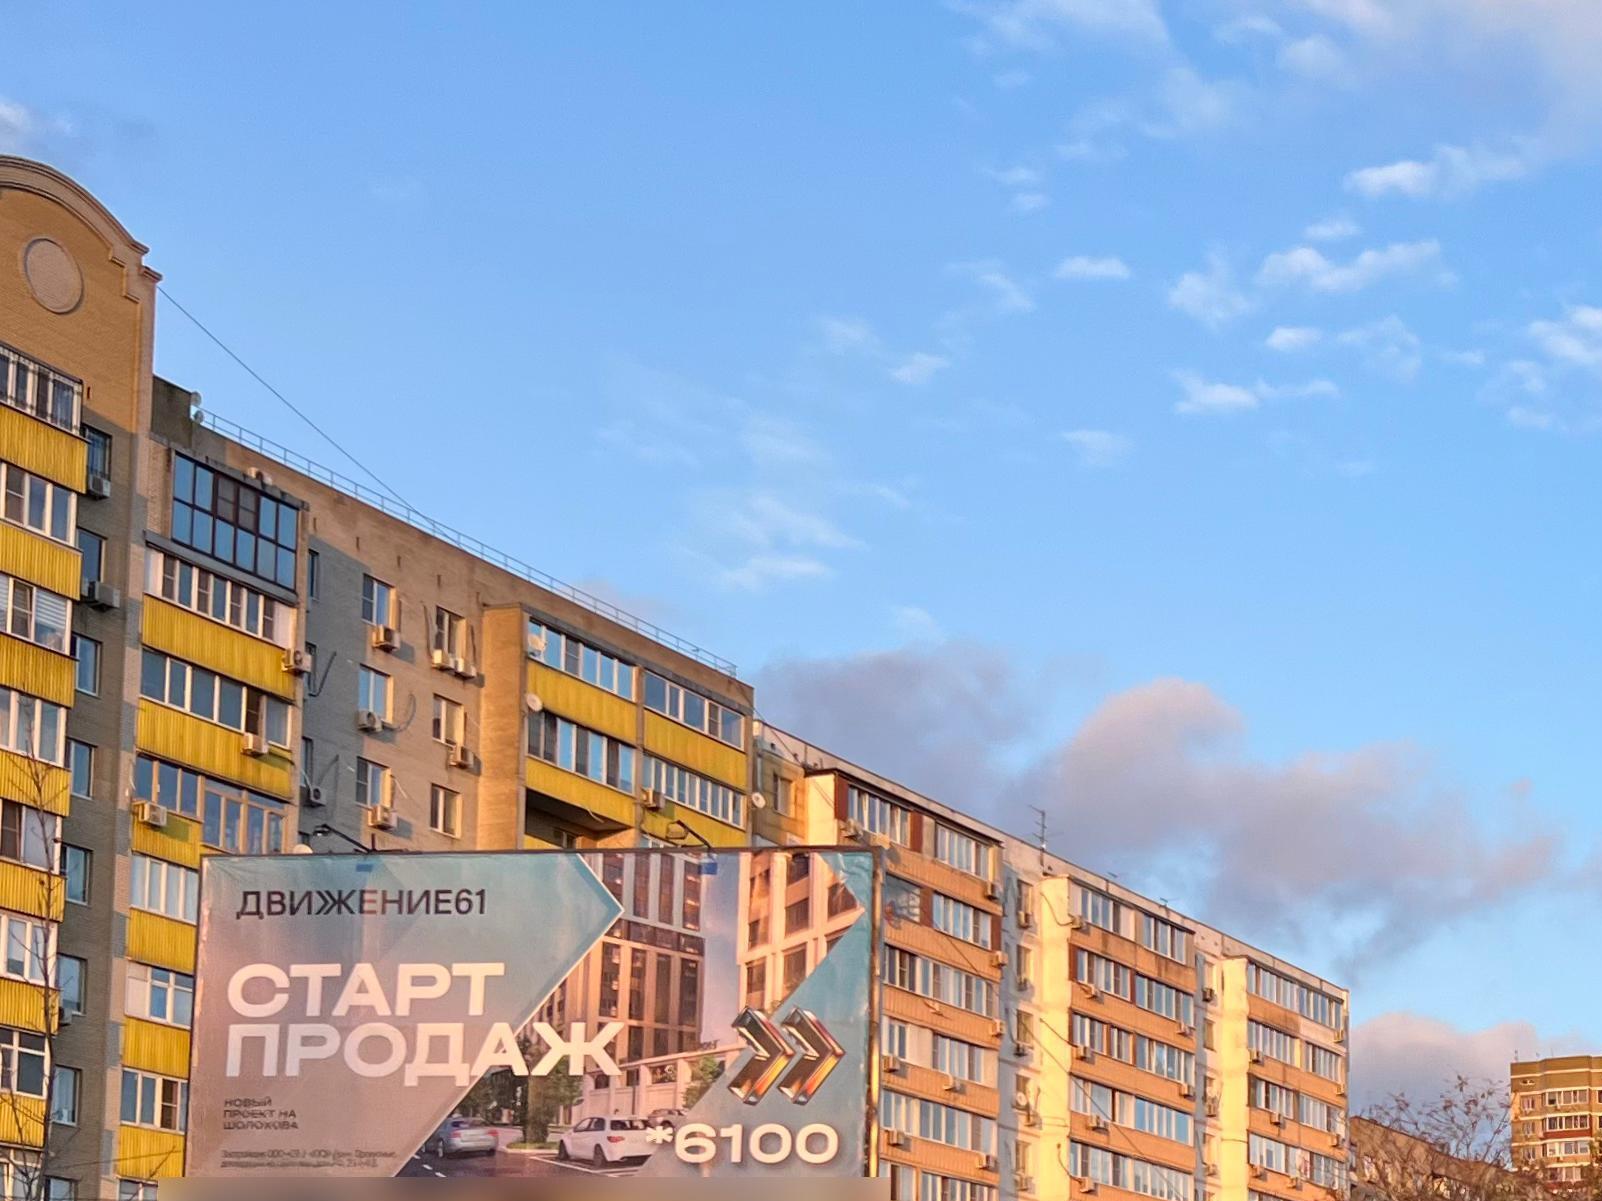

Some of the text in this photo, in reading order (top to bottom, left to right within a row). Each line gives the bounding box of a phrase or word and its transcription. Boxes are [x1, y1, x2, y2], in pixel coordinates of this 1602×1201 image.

[236, 889, 487, 919] ДВИЖЕНИЕ61
[227, 962, 505, 1018] СТАРТ
[226, 1022, 624, 1087] ПРОДАЖ
[223, 1109, 297, 1119] ПРОЕКТ НА
